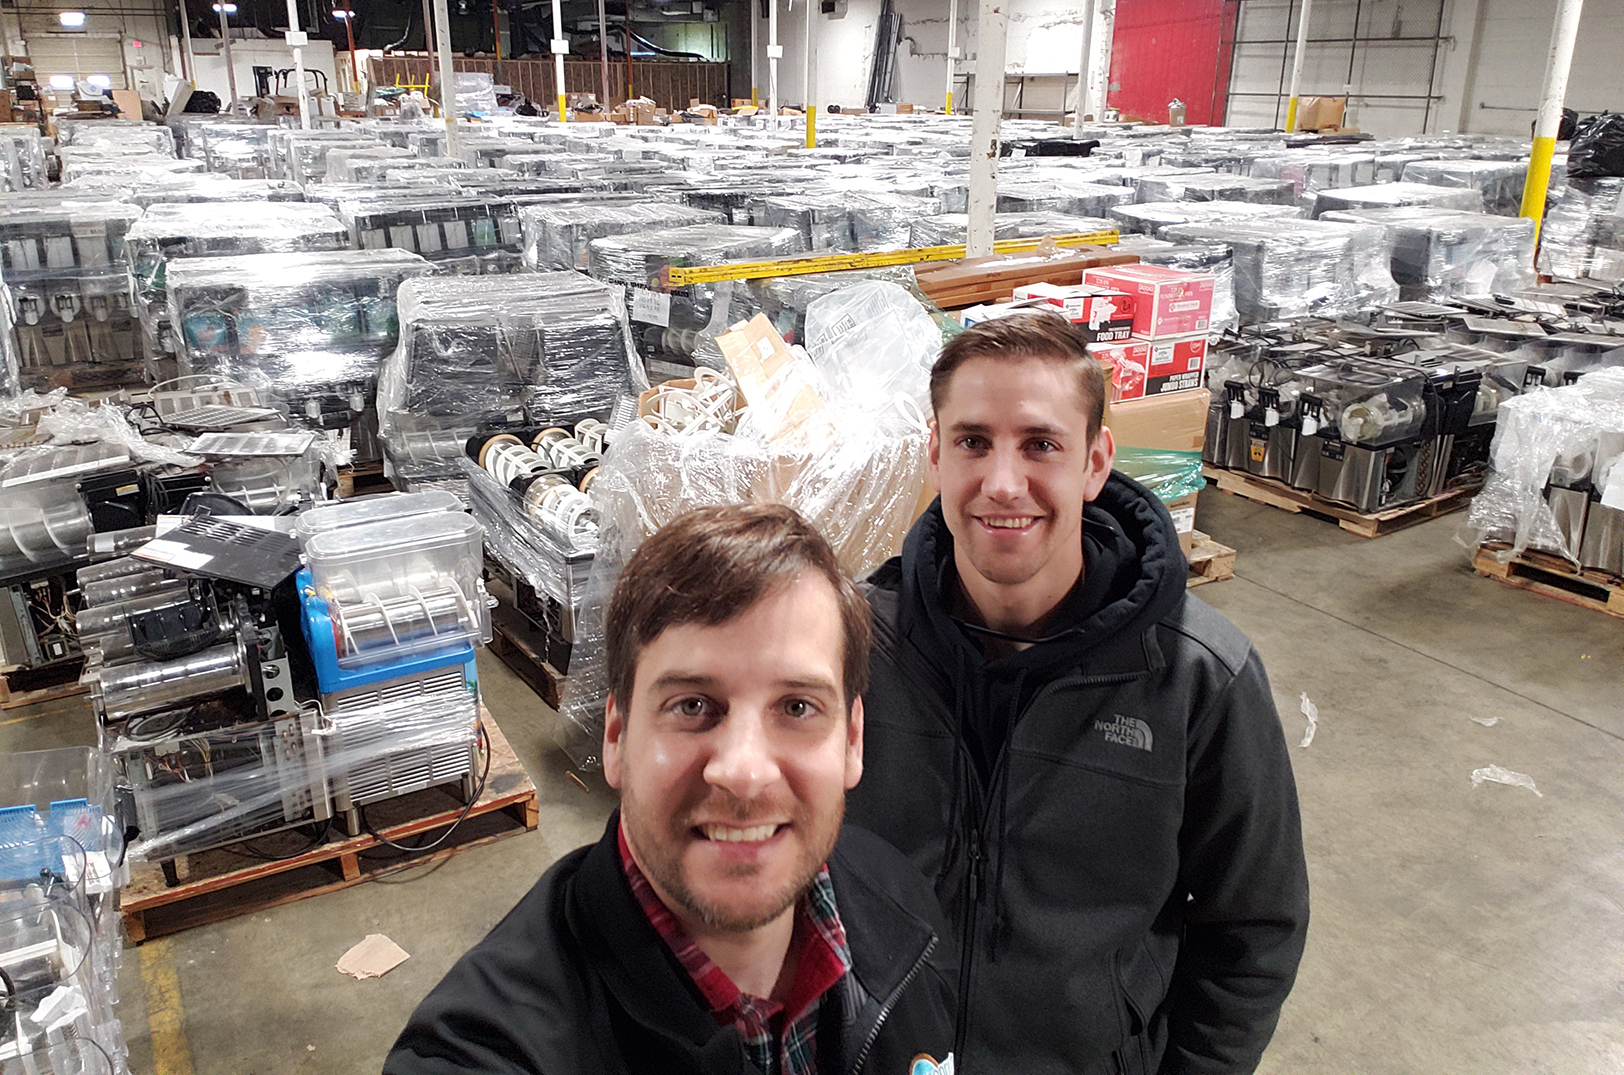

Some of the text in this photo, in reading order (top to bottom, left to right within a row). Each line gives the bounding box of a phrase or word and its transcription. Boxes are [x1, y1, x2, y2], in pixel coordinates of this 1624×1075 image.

[1096, 330, 1130, 342] FOOD TRAY
[1161, 378, 1198, 392] JUMBO STRAWS
[1114, 714, 1136, 727] THE
[1094, 720, 1134, 736] NORTH
[1104, 731, 1133, 745] FACE
